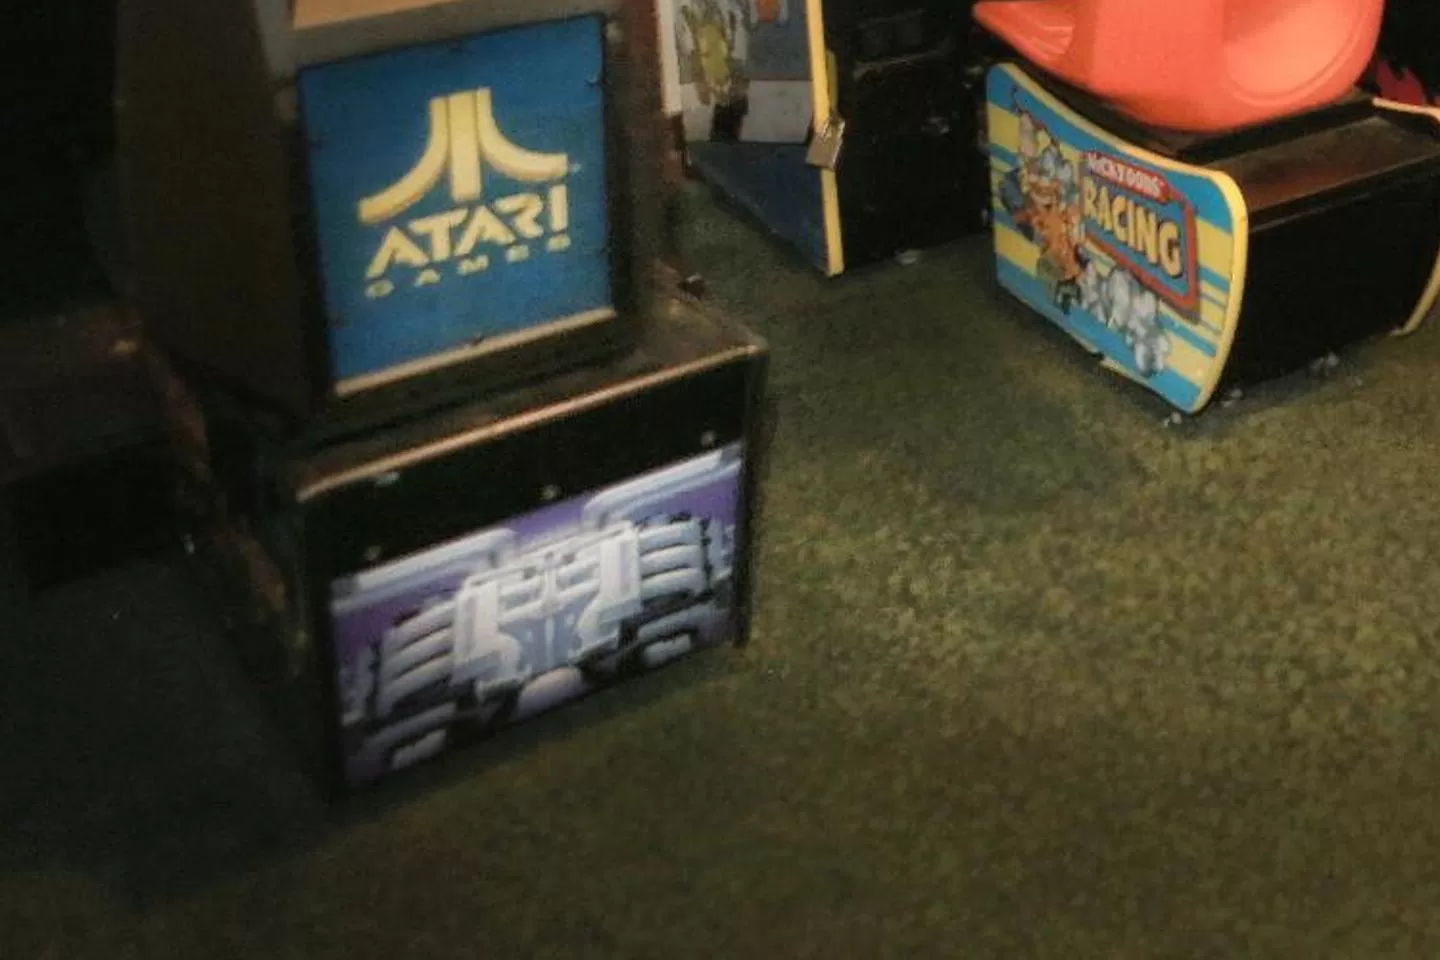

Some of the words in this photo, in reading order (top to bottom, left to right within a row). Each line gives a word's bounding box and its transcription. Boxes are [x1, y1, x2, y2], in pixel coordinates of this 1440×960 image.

[364, 234, 571, 300] GAMES
[365, 184, 568, 279] ATARI
[1082, 176, 1181, 277] RACING
